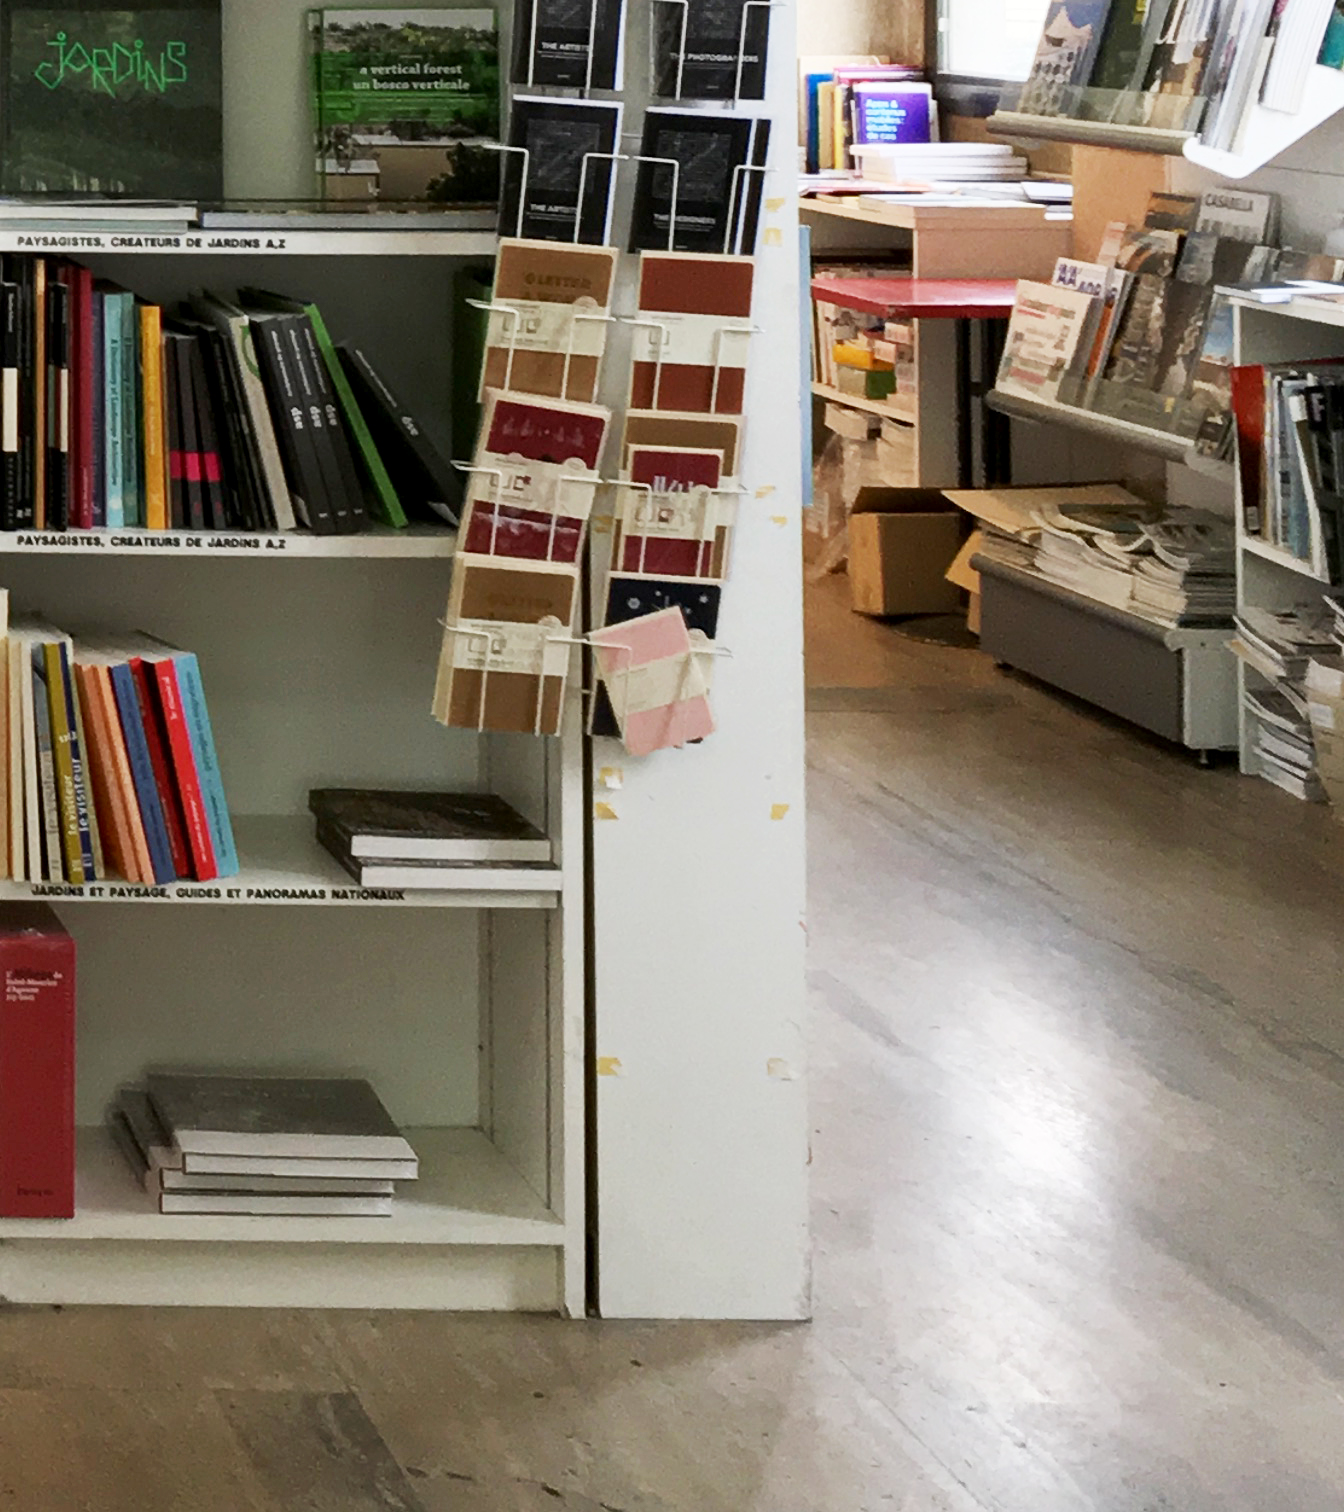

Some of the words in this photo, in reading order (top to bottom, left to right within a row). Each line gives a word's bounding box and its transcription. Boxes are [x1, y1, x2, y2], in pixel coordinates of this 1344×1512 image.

[359, 66, 368, 75] a
[370, 62, 421, 75] vertical
[423, 62, 464, 75] forest
[352, 80, 371, 90] un
[371, 78, 410, 90] bosco
[411, 78, 471, 91] verticale
[17, 236, 106, 248] PAYSAGISTES,
[110, 237, 180, 248] CREATEURS
[186, 238, 202, 249] DE
[207, 238, 260, 250] JARDINS
[265, 239, 286, 251] A,Z
[17, 536, 106, 548] PAYSAGISTES,
[110, 537, 180, 548] CREATEURS
[185, 538, 202, 549] DE
[207, 538, 260, 549] JARDINS
[265, 538, 286, 550] A,Z
[31, 887, 85, 896] JARDINS
[89, 888, 105, 896] ET
[109, 888, 171, 899] PAYSAGE,
[175, 888, 222, 898] GUIDES
[226, 889, 242, 898] ET
[246, 889, 326, 899] PANORAMAS
[331, 889, 406, 900] NATIONAUX
